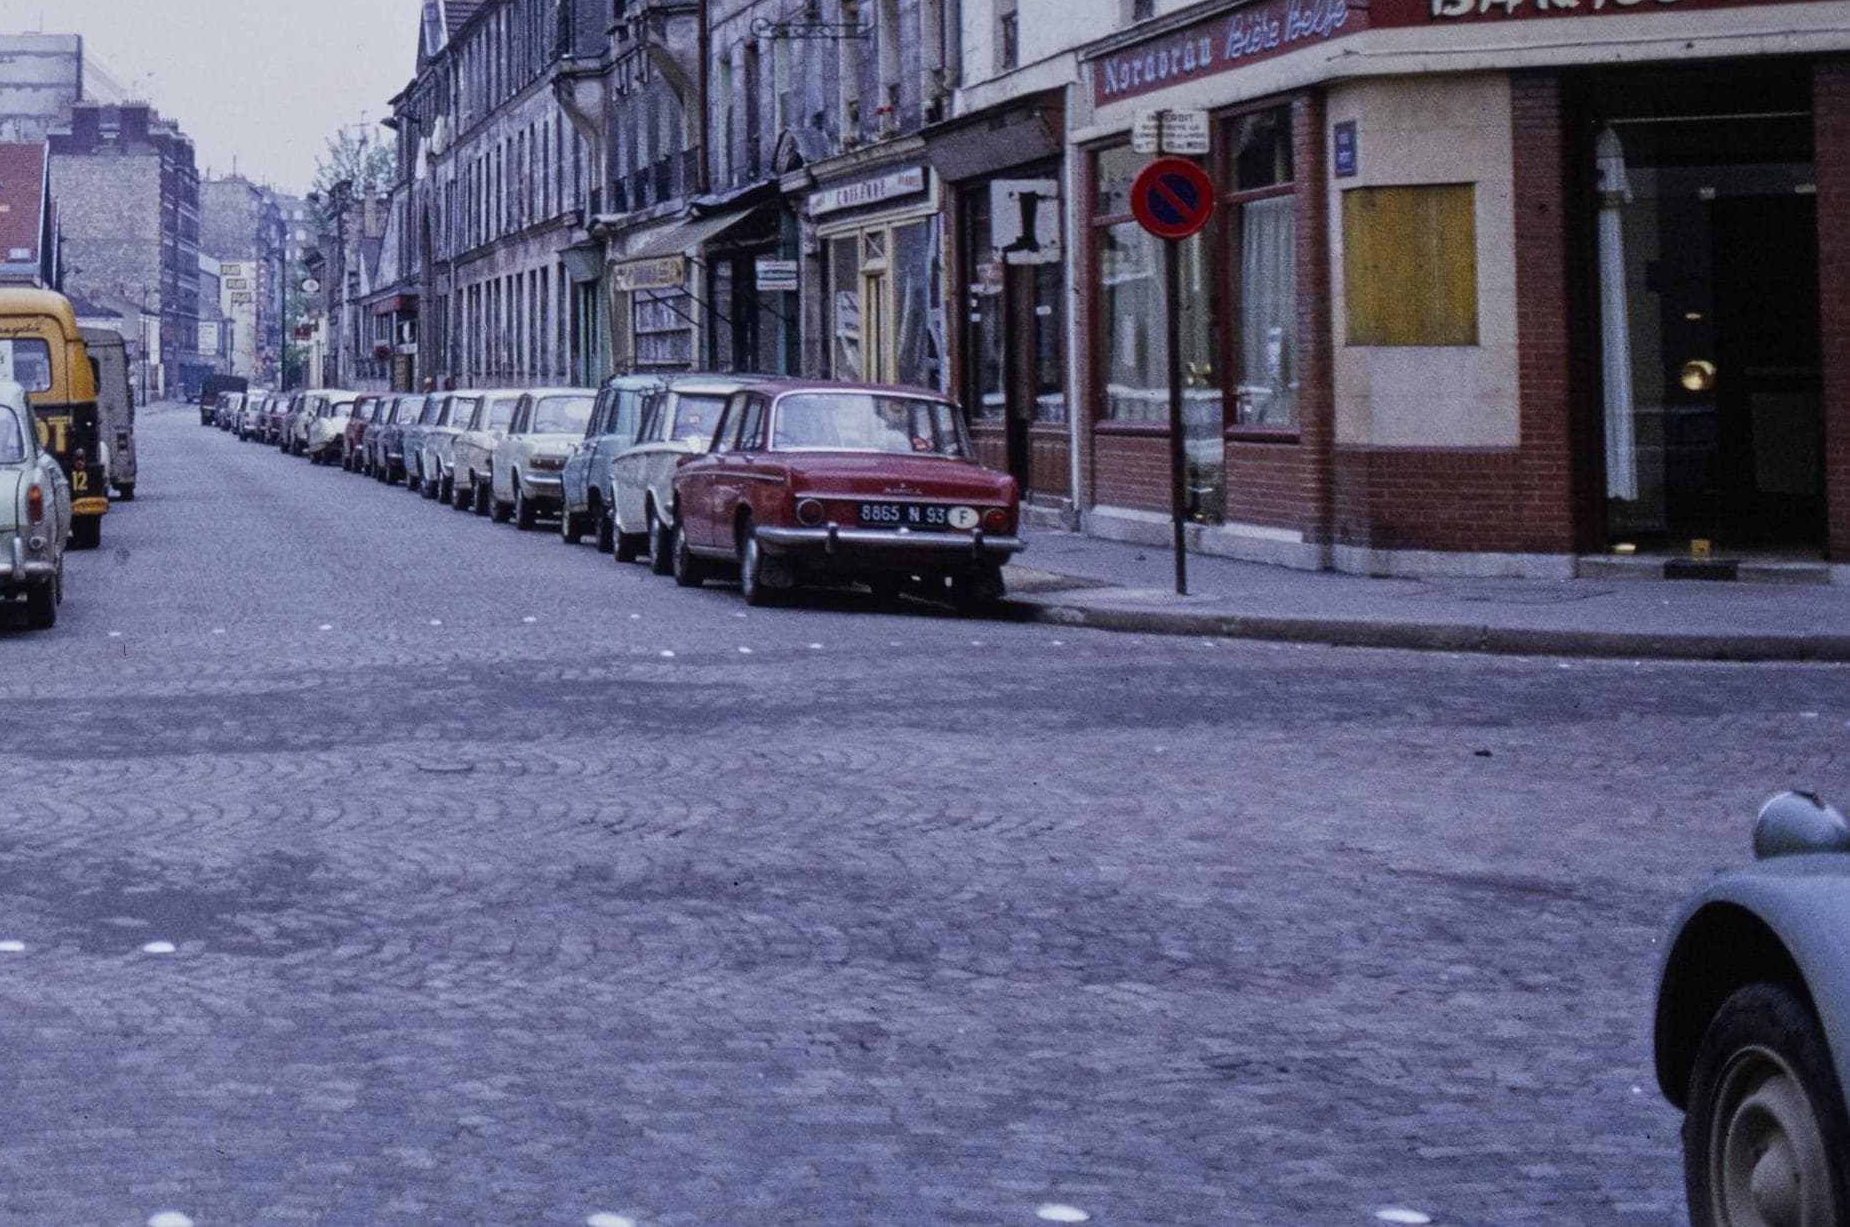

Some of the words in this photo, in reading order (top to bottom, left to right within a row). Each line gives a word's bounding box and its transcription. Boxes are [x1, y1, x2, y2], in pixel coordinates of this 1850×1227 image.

[1146, 113, 1194, 123] INERDIT
[72, 470, 89, 492] 12
[861, 504, 900, 521] 8865
[908, 506, 920, 522] N
[926, 507, 946, 524] 93
[959, 510, 968, 525] F
